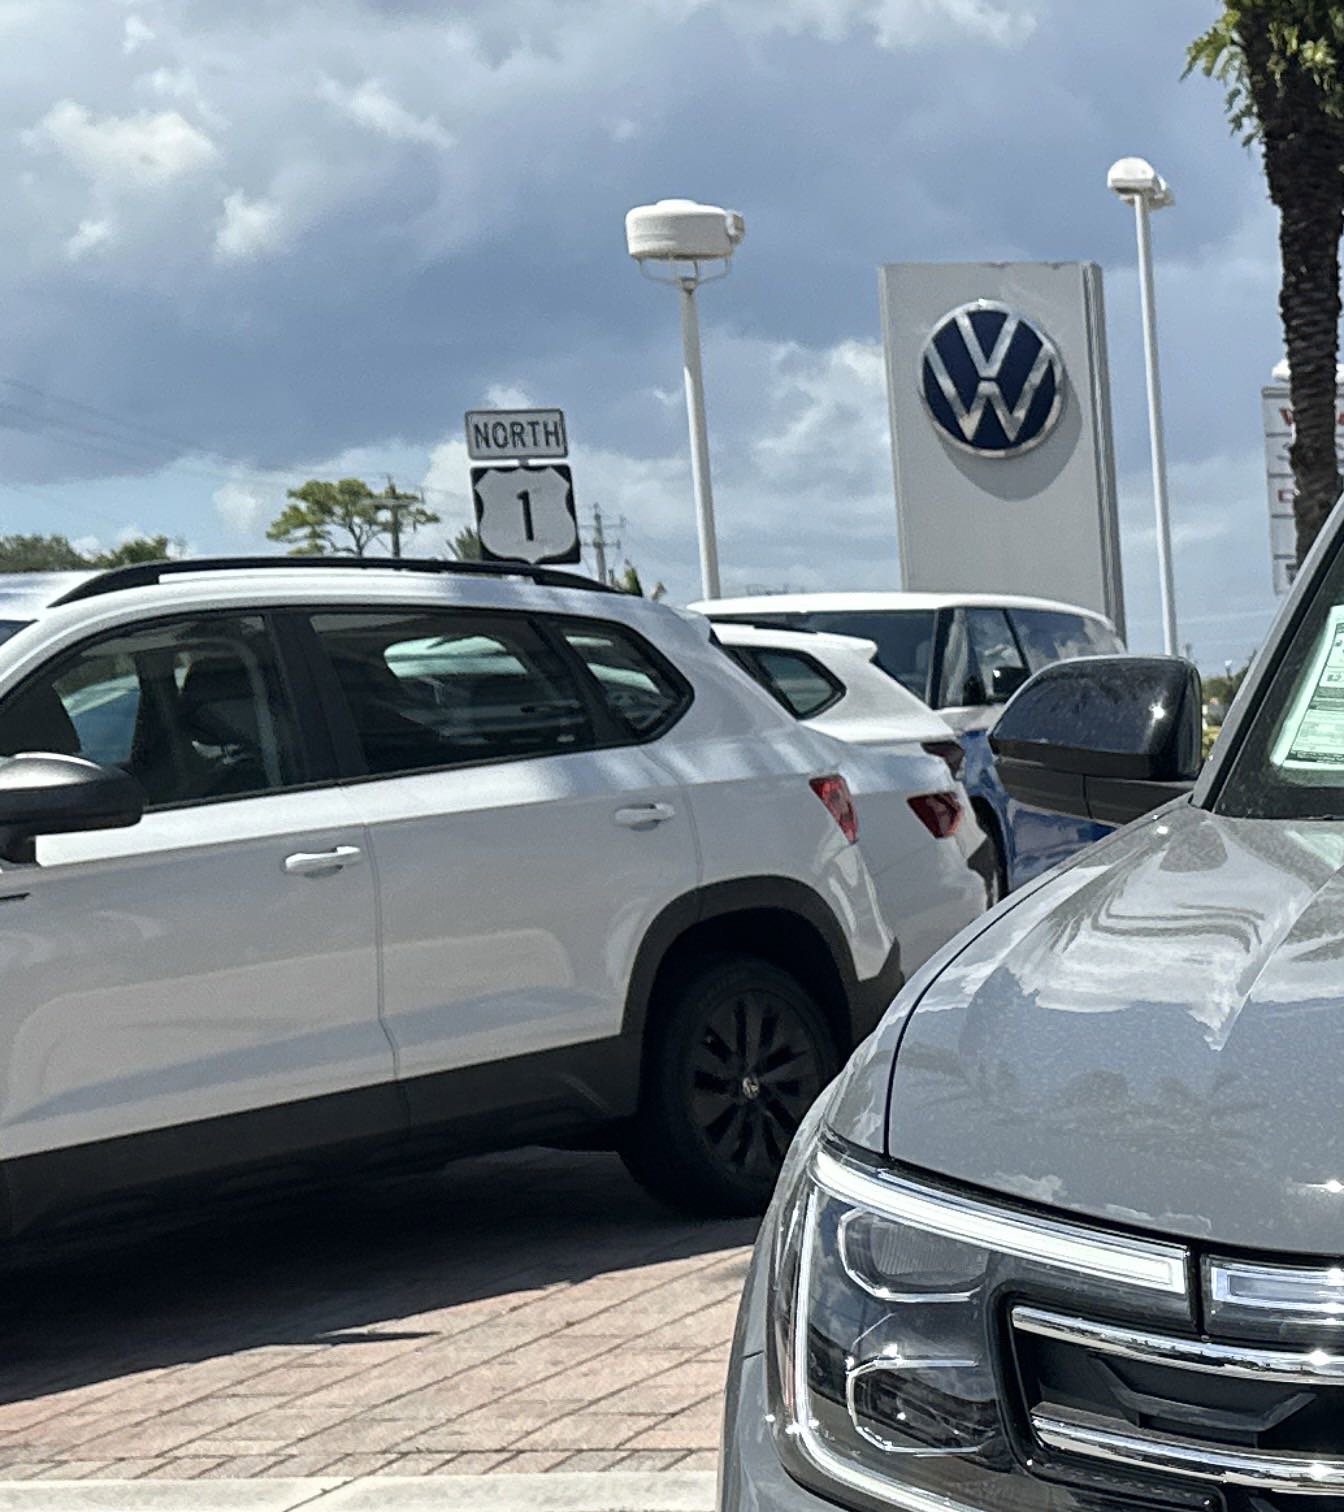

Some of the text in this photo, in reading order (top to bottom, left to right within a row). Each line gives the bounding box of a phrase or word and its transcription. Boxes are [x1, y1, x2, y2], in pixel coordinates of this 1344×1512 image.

[919, 301, 1062, 454] VW
[473, 421, 561, 449] NORTH
[516, 490, 534, 541] 1
